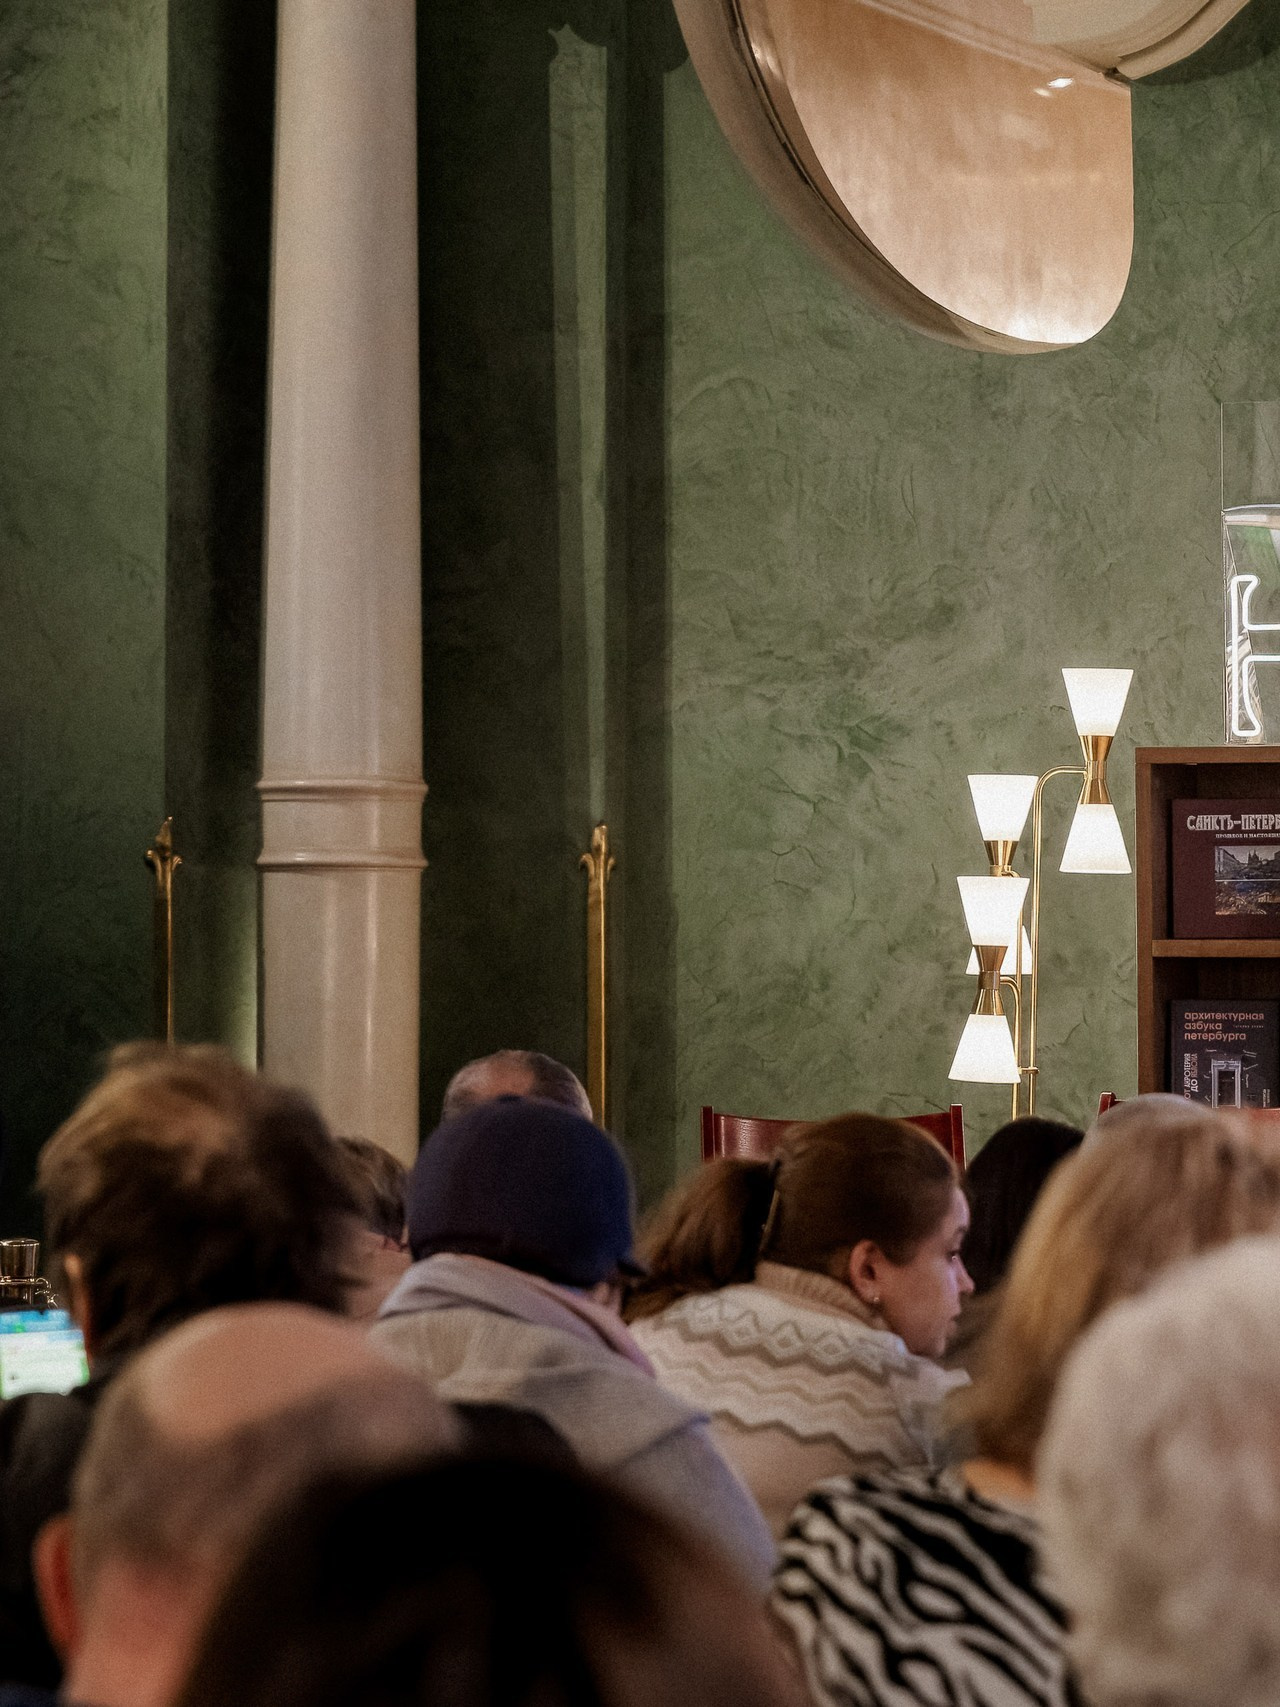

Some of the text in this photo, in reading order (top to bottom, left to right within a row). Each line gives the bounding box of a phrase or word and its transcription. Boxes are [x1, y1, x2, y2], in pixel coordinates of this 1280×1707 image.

[1184, 1012, 1265, 1021] архитектурная
[1184, 1021, 1222, 1031] азбука
[1184, 1031, 1246, 1042] петербурга
[1191, 1078, 1199, 1092] ДО
